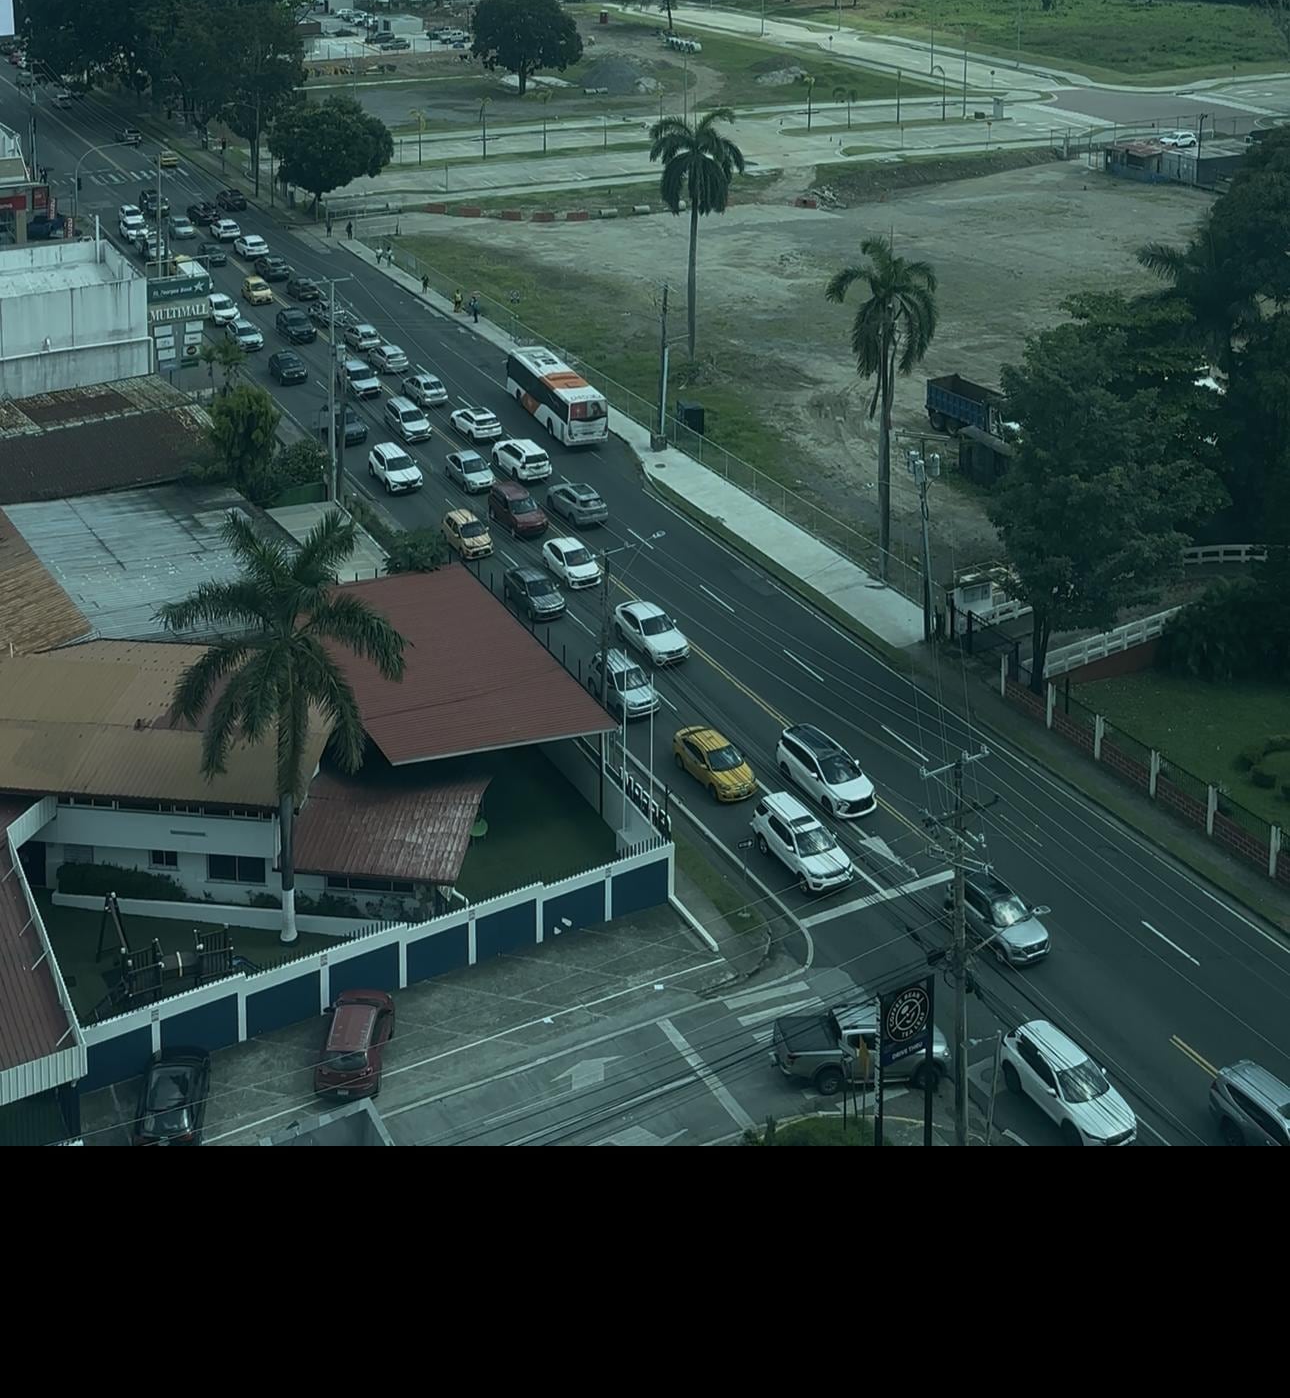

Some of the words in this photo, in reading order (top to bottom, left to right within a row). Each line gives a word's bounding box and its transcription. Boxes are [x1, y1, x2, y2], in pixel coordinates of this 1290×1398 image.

[150, 304, 208, 321] MULTIMALL
[889, 999, 903, 1026] COFFEE
[904, 992, 920, 1000] BEAN
[902, 1029, 913, 1038] TEA
[914, 1012, 925, 1029] LEAF
[892, 1048, 907, 1059] DRIVE
